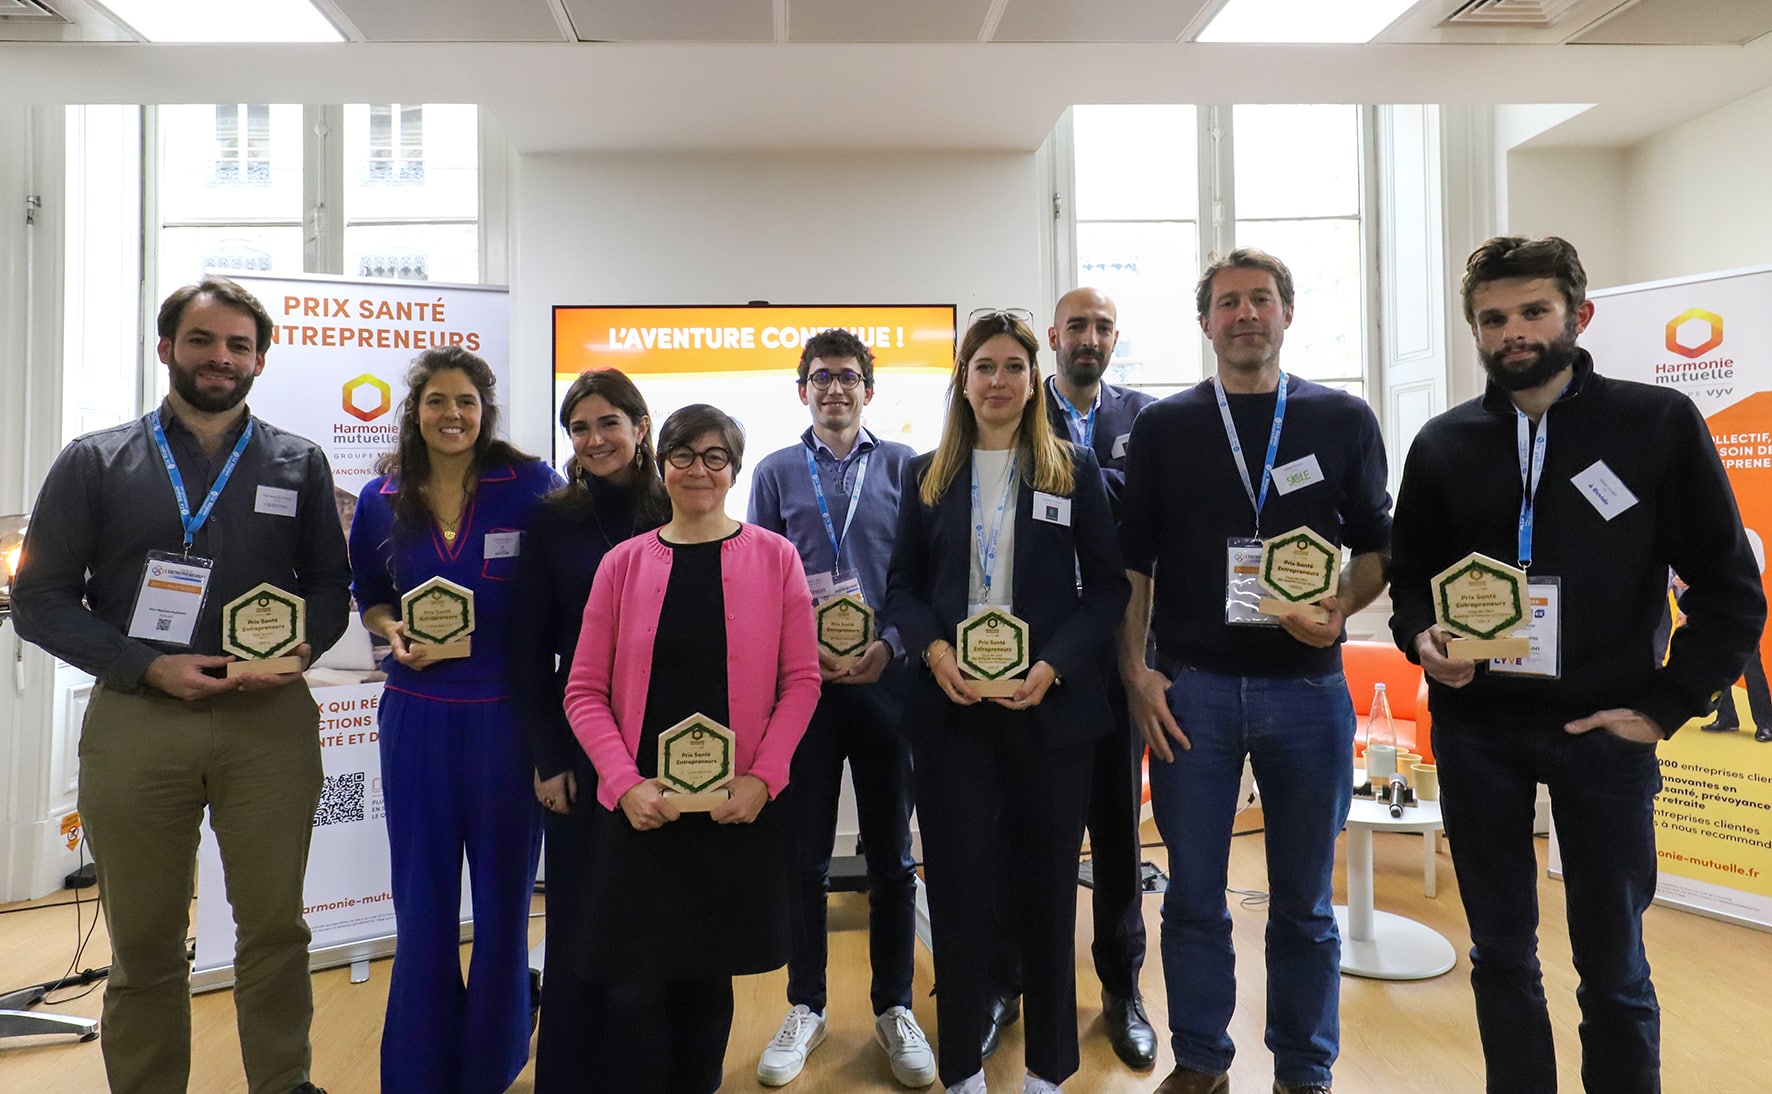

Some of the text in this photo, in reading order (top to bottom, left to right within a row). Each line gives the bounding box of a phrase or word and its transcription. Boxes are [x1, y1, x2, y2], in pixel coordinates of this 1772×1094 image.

[284, 296, 446, 322] PRIX SANTÉ
[271, 325, 481, 351] NTREPRENEURS
[609, 327, 755, 349] L'AVENTURE
[760, 326, 891, 349] CONUE
[1655, 357, 1734, 374] Harmonie
[1655, 369, 1734, 384] mutuelle
[333, 423, 399, 434] Harmonie
[333, 434, 399, 444] mutuelle
[1711, 432, 1772, 444] LLECTIF,
[1719, 446, 1753, 457] SOIN
[332, 467, 371, 475] ANÇONS
[1277, 567, 1319, 577] Entrepreneurs
[1456, 601, 1506, 609] Entrepreneurs
[242, 624, 285, 633] Entrepreneurs
[329, 700, 355, 713] QUI
[360, 694, 378, 709] RÉ
[318, 715, 372, 731] CTIONS
[319, 732, 344, 747] NTÉ
[349, 733, 366, 745] ET
[1658, 758, 1678, 768] 000
[1681, 764, 1744, 779] entreprises
[1661, 775, 1737, 793] nnovantes en
[1662, 795, 1706, 810] retraite
[1664, 786, 1771, 811] santé, prévoyance
[1654, 809, 1711, 825] ntreprises
[1713, 819, 1761, 835] clientes
[1661, 820, 1668, 828] à
[1671, 823, 1698, 834] nous
[1700, 828, 1772, 849] recommand
[1657, 850, 1760, 878] onie-mutuelle.fr
[302, 892, 393, 915] armonie-mutu
